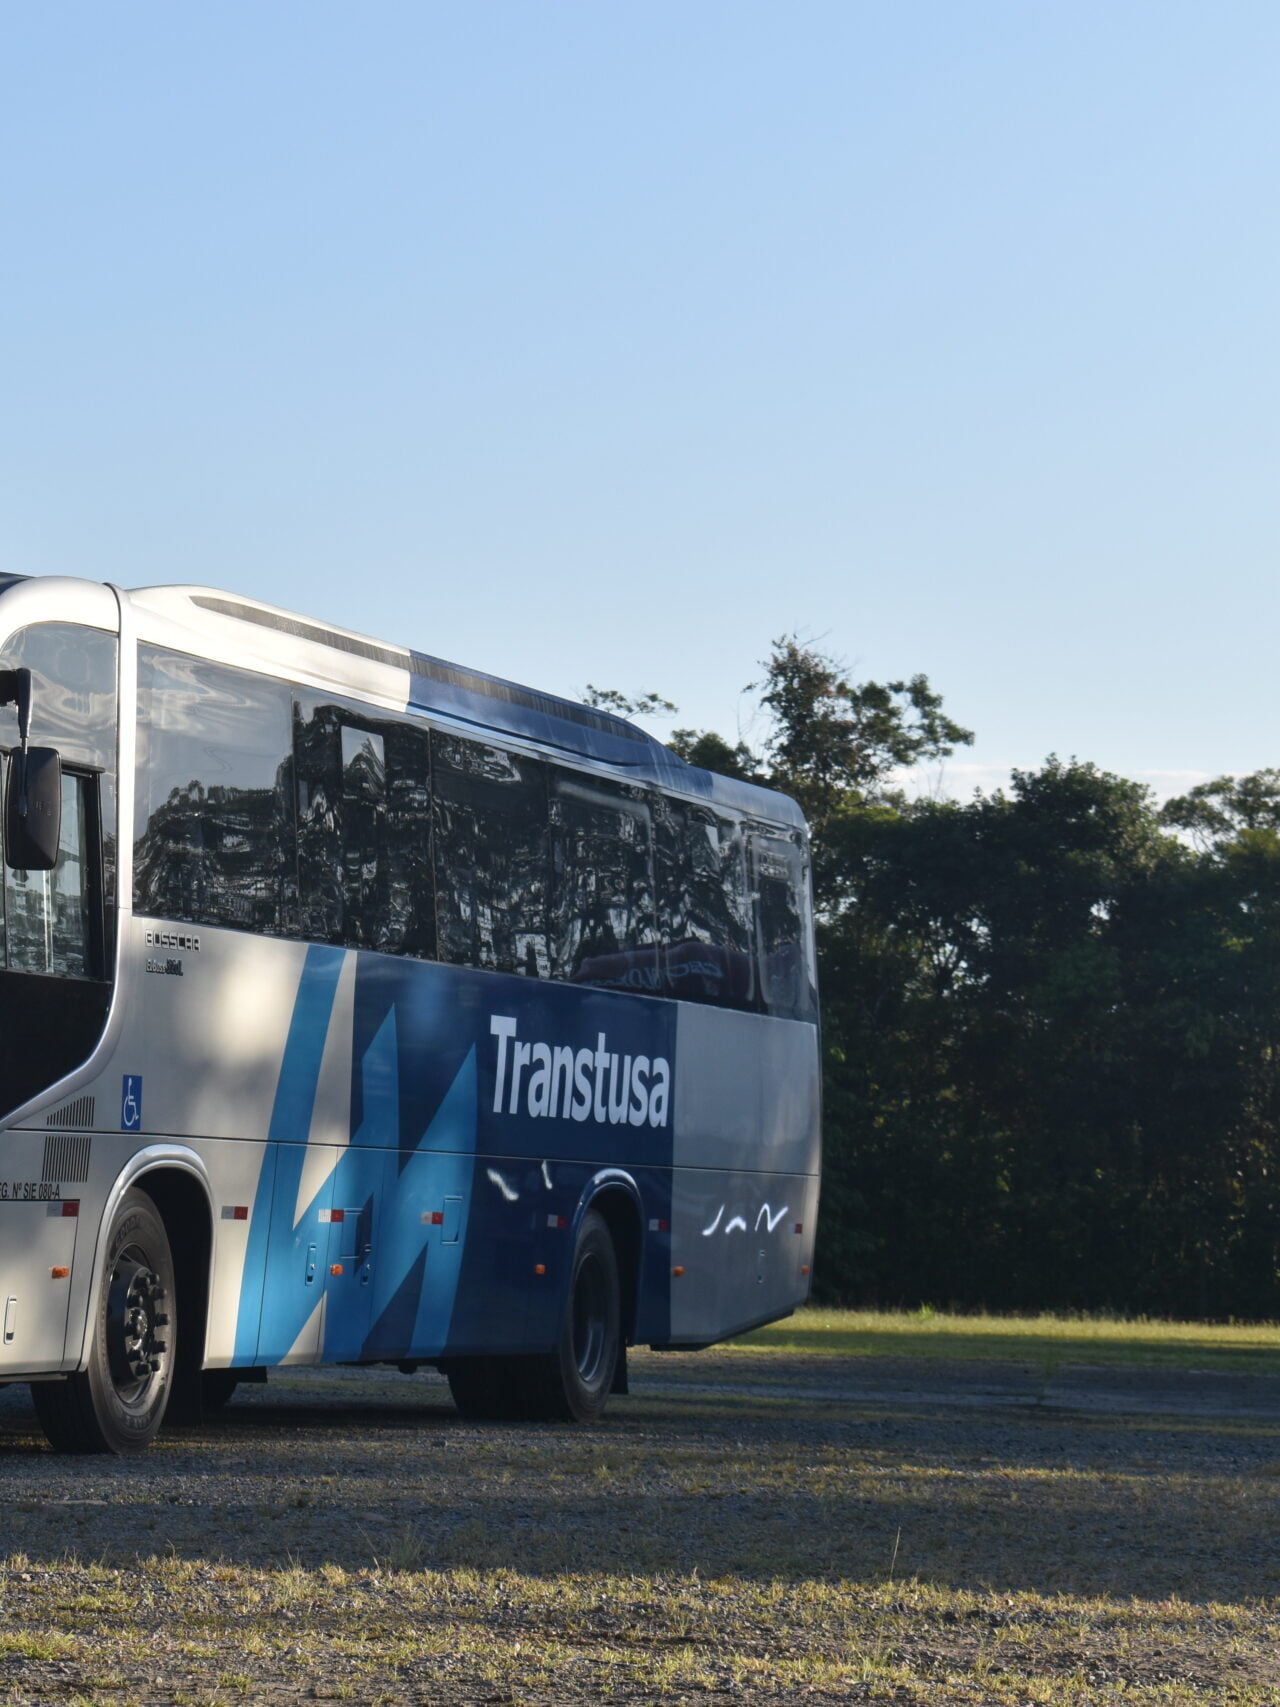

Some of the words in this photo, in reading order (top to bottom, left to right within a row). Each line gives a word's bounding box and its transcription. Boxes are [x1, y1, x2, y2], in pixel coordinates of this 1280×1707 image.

[145, 929, 200, 952] BUSSCAR
[489, 1015, 671, 1128] Transtusa
[23, 1182, 37, 1199] SIE
[38, 1183, 60, 1199] 080-A
